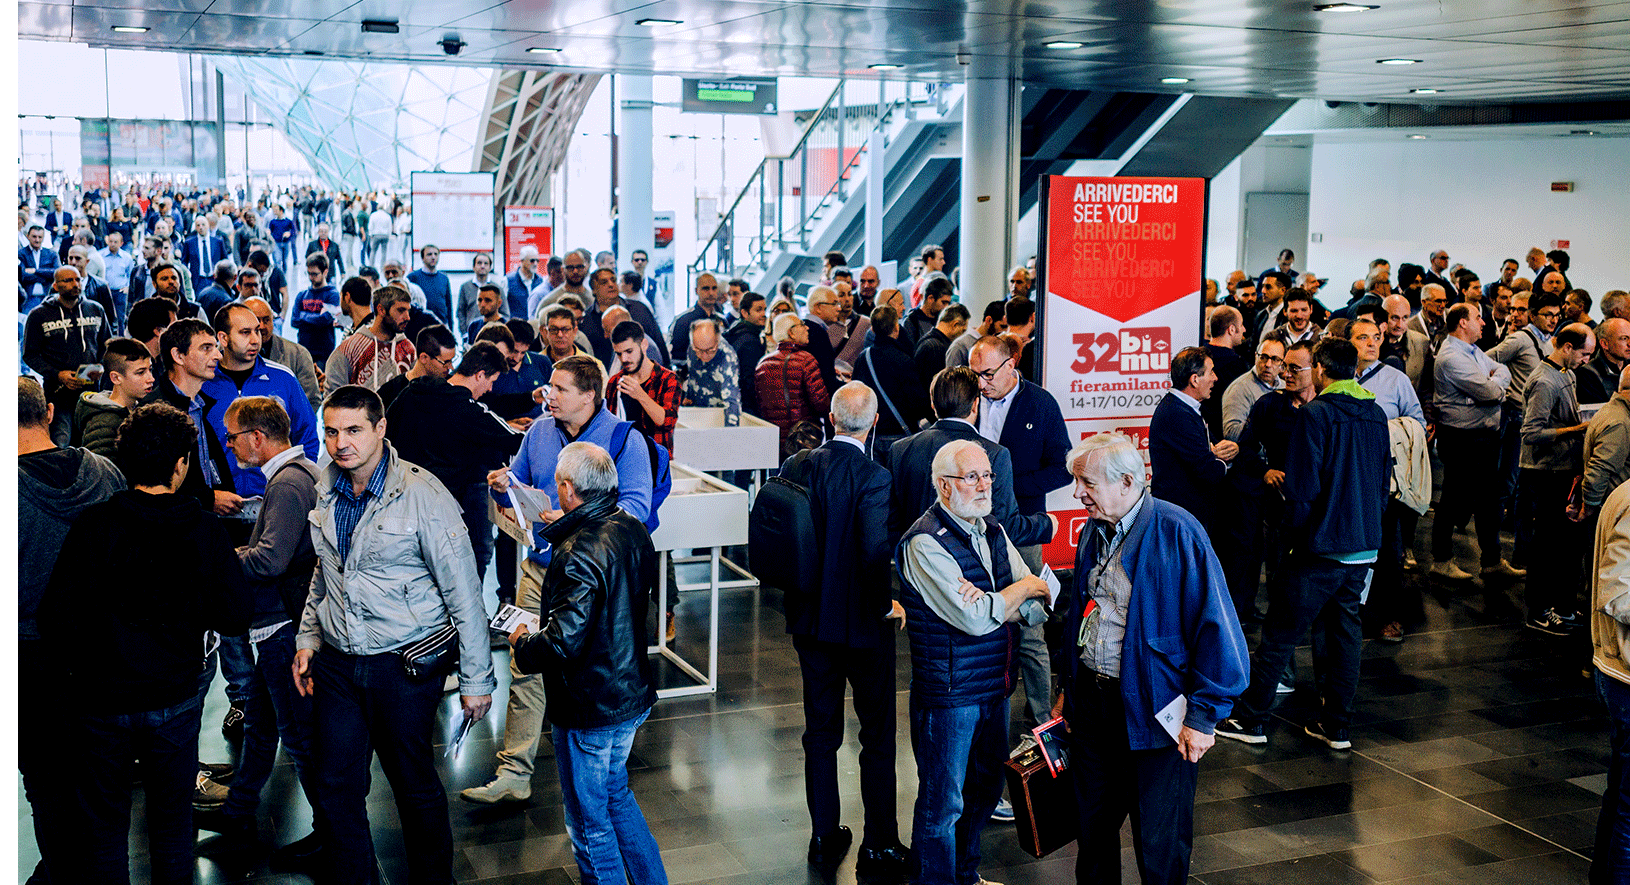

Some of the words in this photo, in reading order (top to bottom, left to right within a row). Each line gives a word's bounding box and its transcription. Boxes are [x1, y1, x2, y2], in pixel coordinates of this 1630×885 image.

[1073, 183, 1178, 203] ARRIVEDERCI
[1073, 204, 1103, 223] SEE
[1107, 204, 1139, 223] YOU
[1073, 222, 1177, 240] ARRIVEDERCI
[1073, 242, 1101, 260] SEE
[1107, 242, 1137, 260] YOU
[1072, 260, 1175, 278] ARRIVEDERCI
[1105, 280, 1136, 298] YOU
[1070, 332, 1120, 374] 32
[1070, 378, 1171, 393] fieramilano
[1070, 394, 1162, 409] 14-17/10/202
